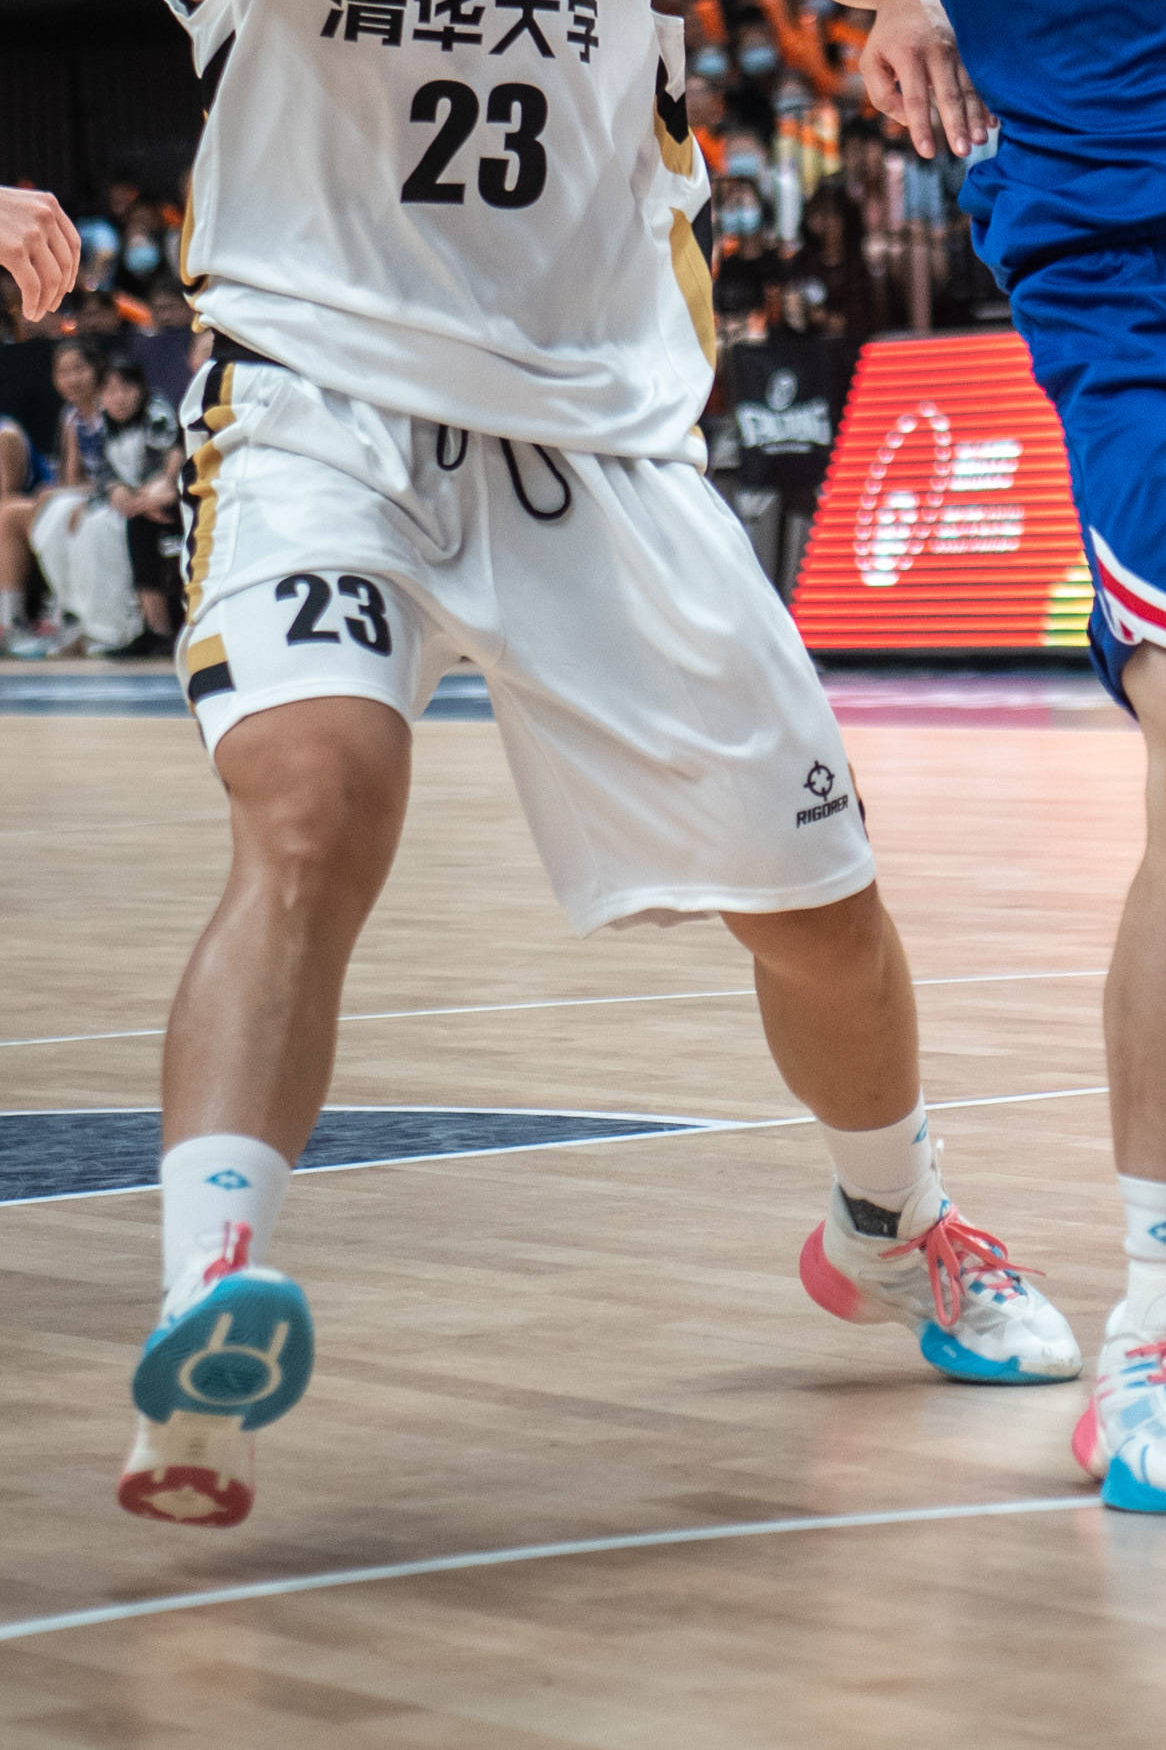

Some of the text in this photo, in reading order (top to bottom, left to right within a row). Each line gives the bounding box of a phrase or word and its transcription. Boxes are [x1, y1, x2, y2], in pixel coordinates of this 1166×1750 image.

[400, 80, 548, 210] 23
[275, 574, 392, 657] 23
[796, 795, 848, 829] RIGORER
